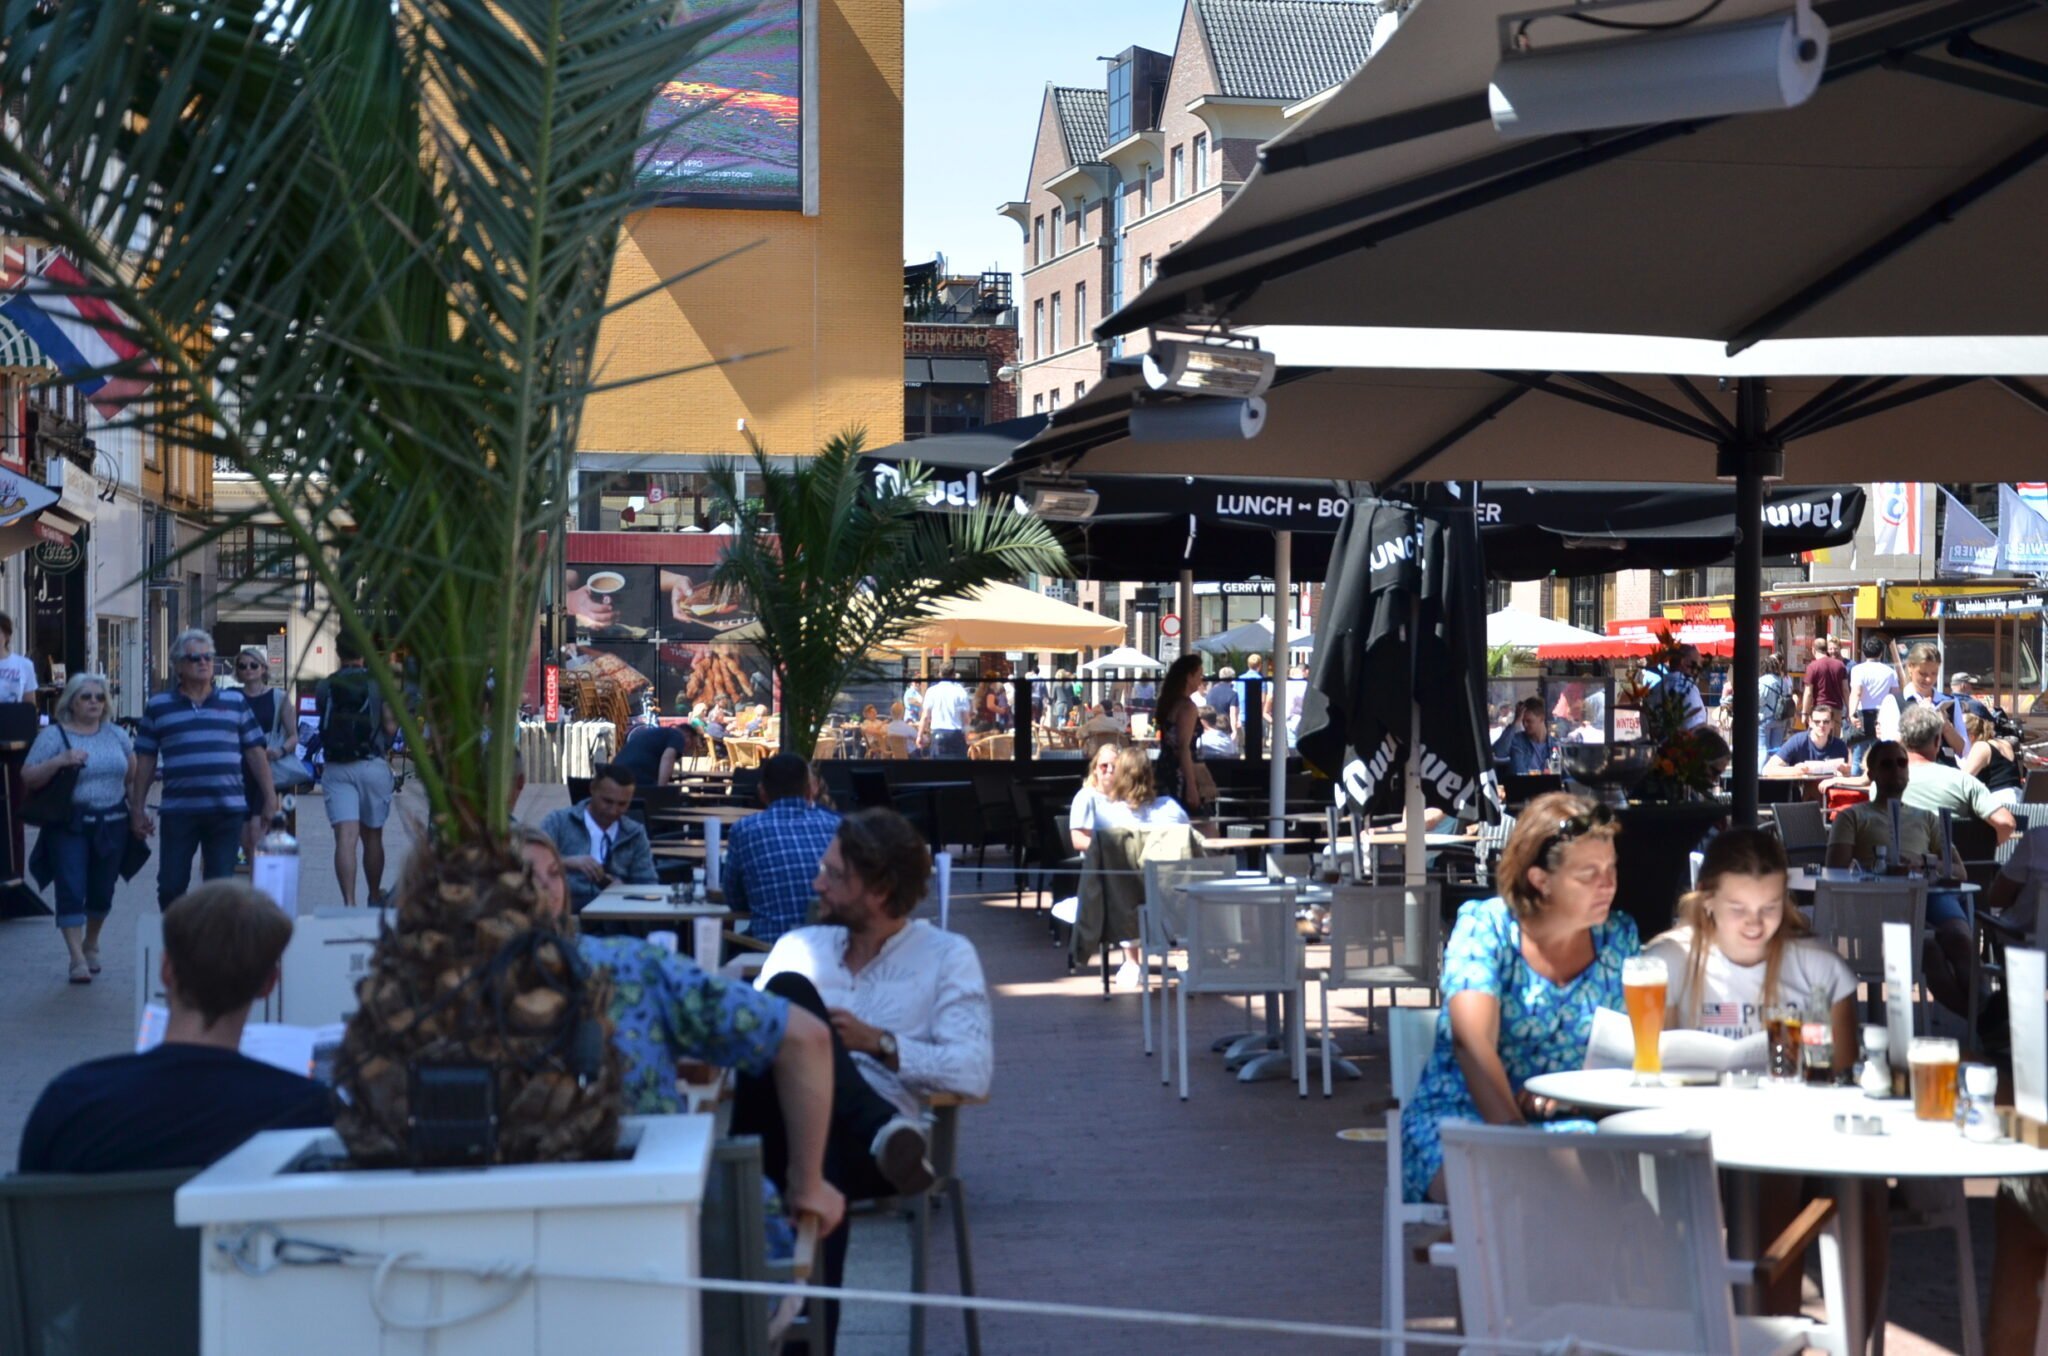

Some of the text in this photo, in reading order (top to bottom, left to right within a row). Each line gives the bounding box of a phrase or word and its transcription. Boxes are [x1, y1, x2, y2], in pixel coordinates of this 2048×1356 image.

[1216, 494, 1502, 523] LUNCH BO ER
[1761, 491, 1842, 530] uvel
[1369, 536, 1414, 573] UNC
[1222, 582, 1259, 593] GERRY
